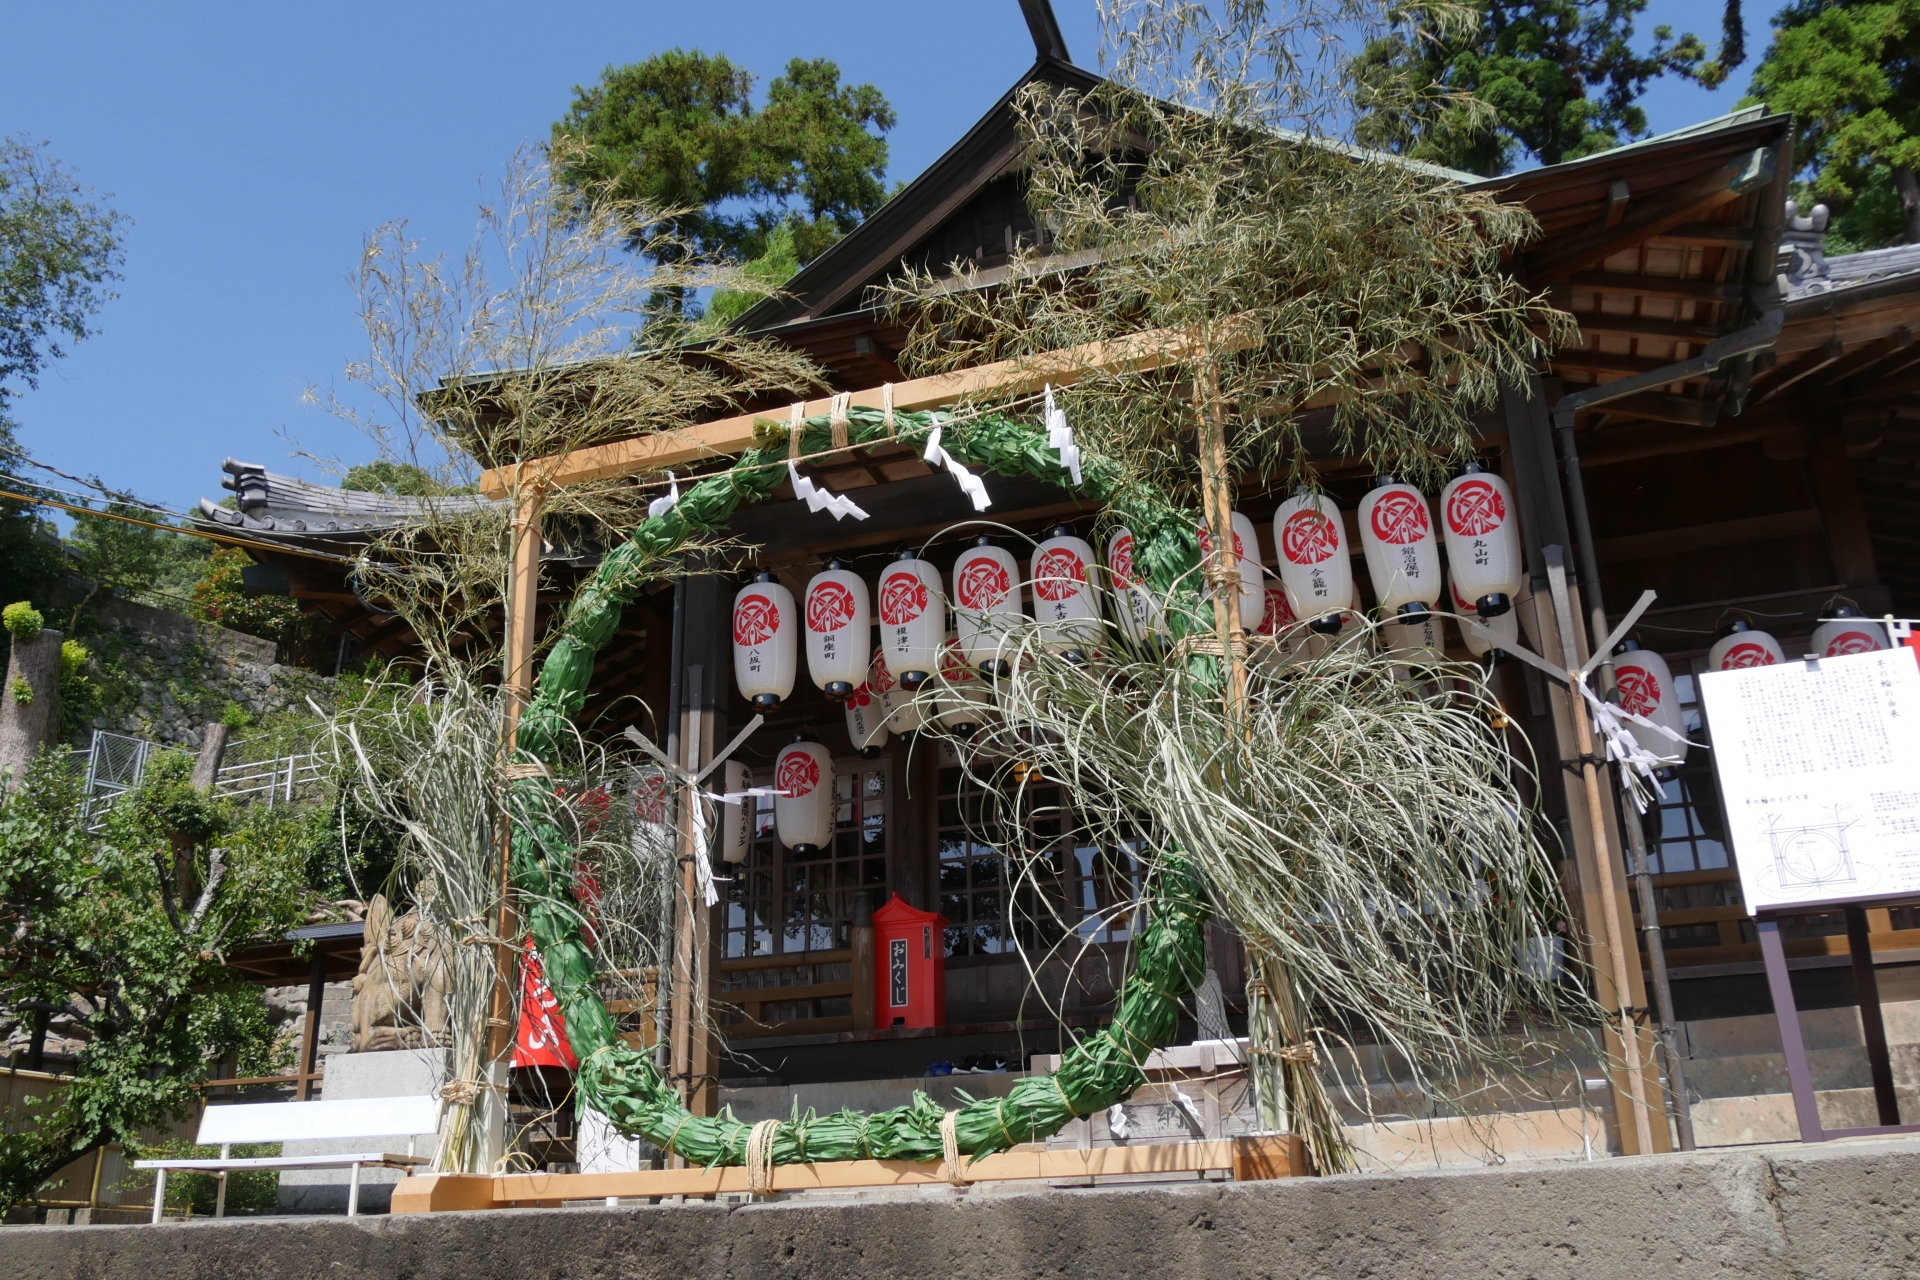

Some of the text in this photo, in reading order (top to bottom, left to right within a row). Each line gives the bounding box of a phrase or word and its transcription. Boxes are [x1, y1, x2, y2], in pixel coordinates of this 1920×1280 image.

[1401, 547, 1420, 579] 鍛冶屋町
[1472, 539, 1489, 566] 丸山町
[1309, 568, 1328, 597] 今籠町
[748, 648, 762, 673] 八坂町
[823, 634, 836, 660] 銅座町
[892, 942, 906, 1005] おみくじ
